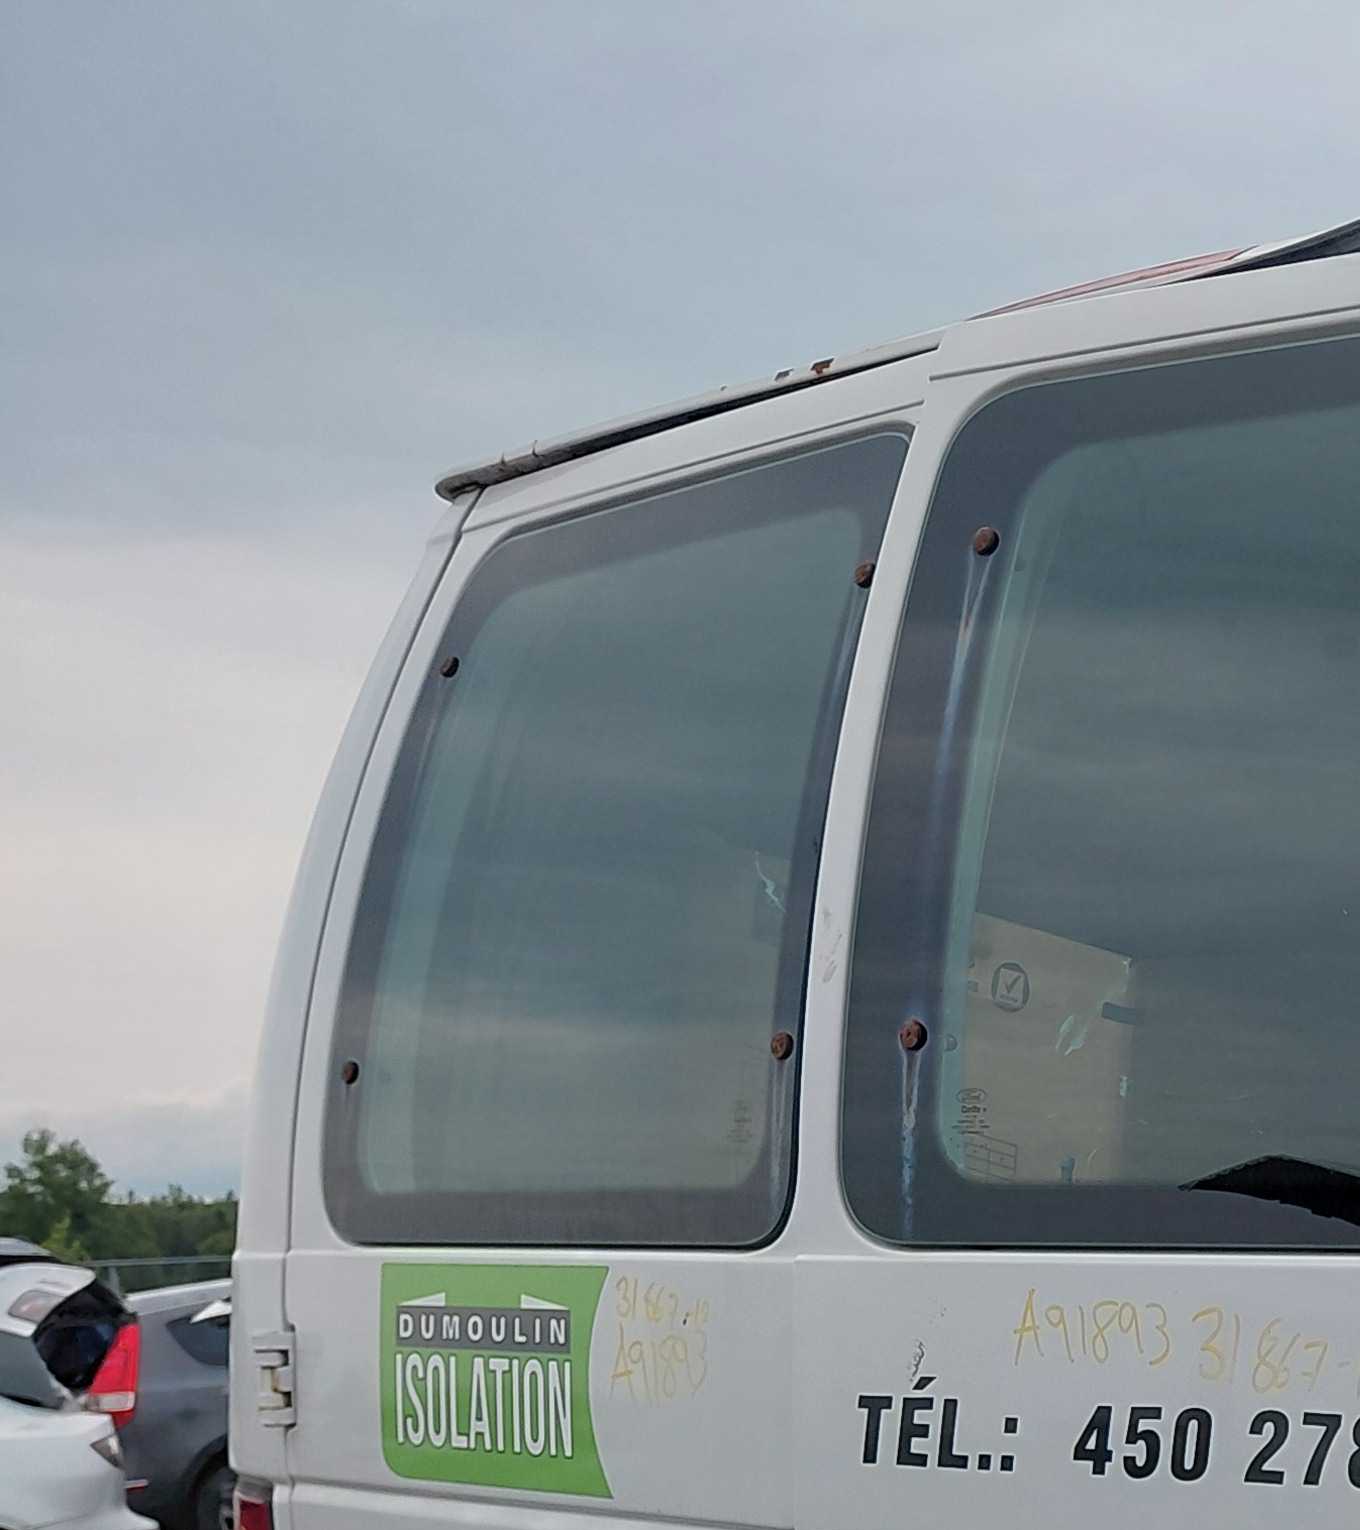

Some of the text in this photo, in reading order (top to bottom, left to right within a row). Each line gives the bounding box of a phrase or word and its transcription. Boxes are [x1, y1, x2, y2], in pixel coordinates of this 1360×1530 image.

[399, 1313, 567, 1345] DUMOULIN
[395, 1352, 573, 1459] ISOLATION
[857, 1376, 1020, 1473] TÉL.:
[1072, 1404, 1213, 1481] 450
